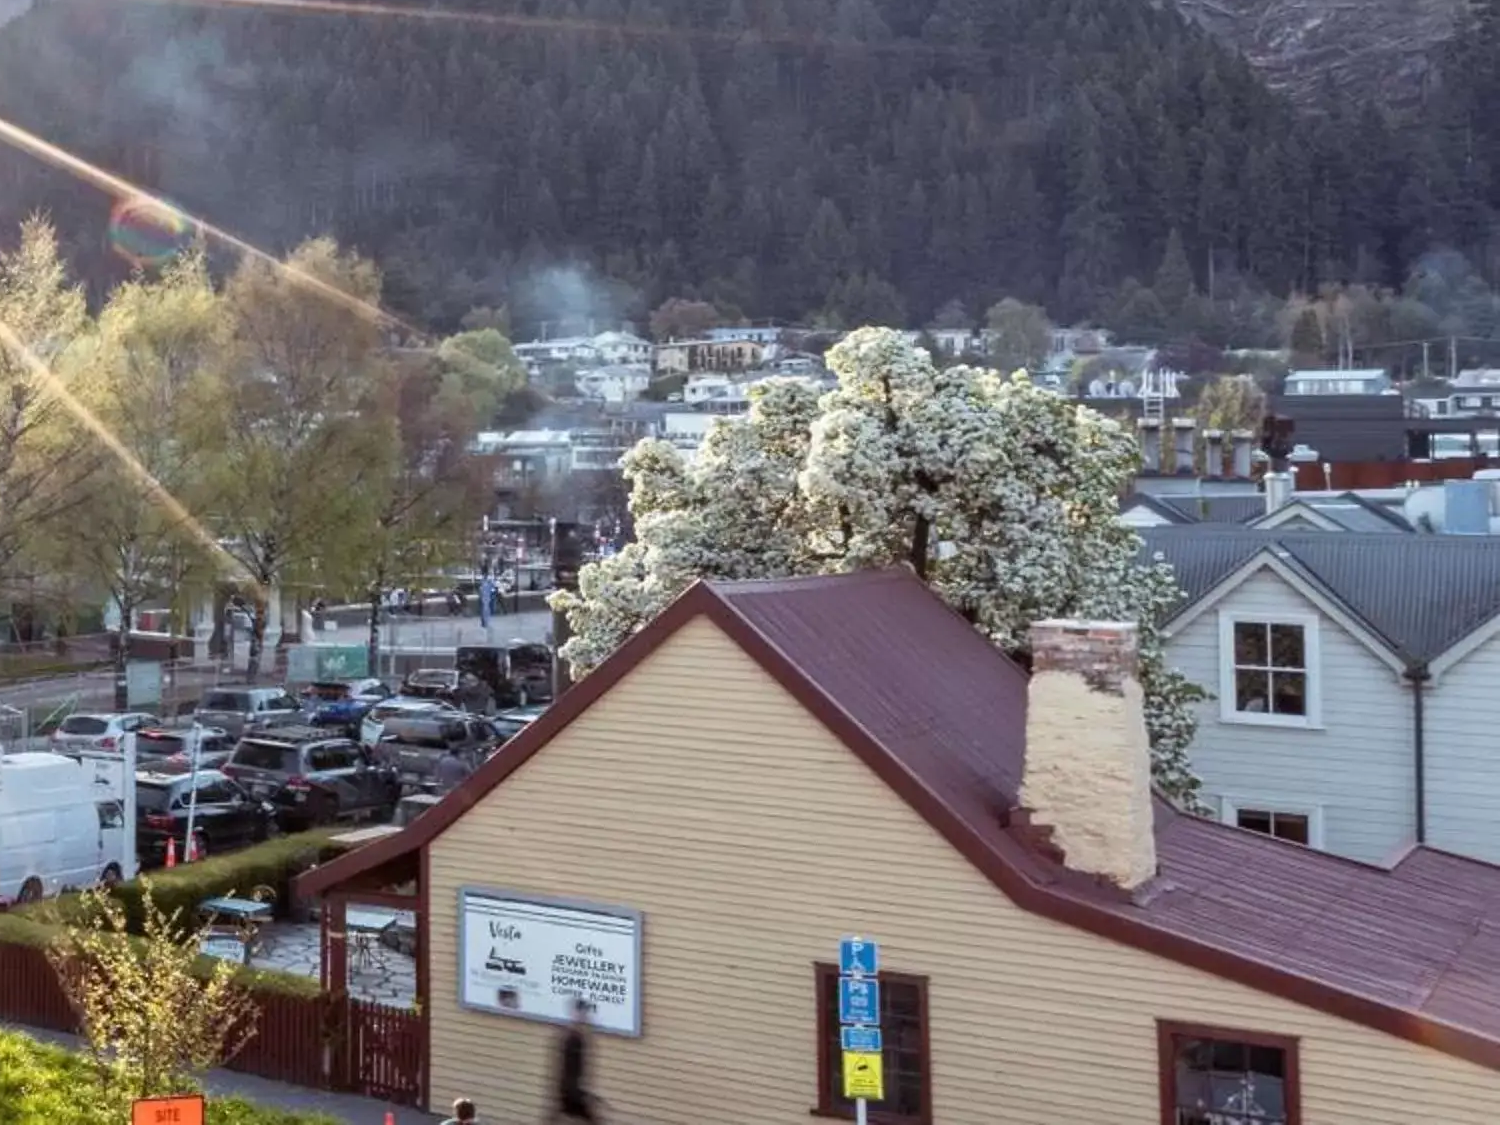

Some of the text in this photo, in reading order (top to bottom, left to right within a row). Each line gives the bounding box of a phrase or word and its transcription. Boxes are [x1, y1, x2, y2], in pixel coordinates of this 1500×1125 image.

[489, 920, 522, 941] Vesta
[552, 954, 625, 974] JEWELLERY
[551, 975, 627, 996] HOMEWARE
[155, 1107, 181, 1124] SITE
